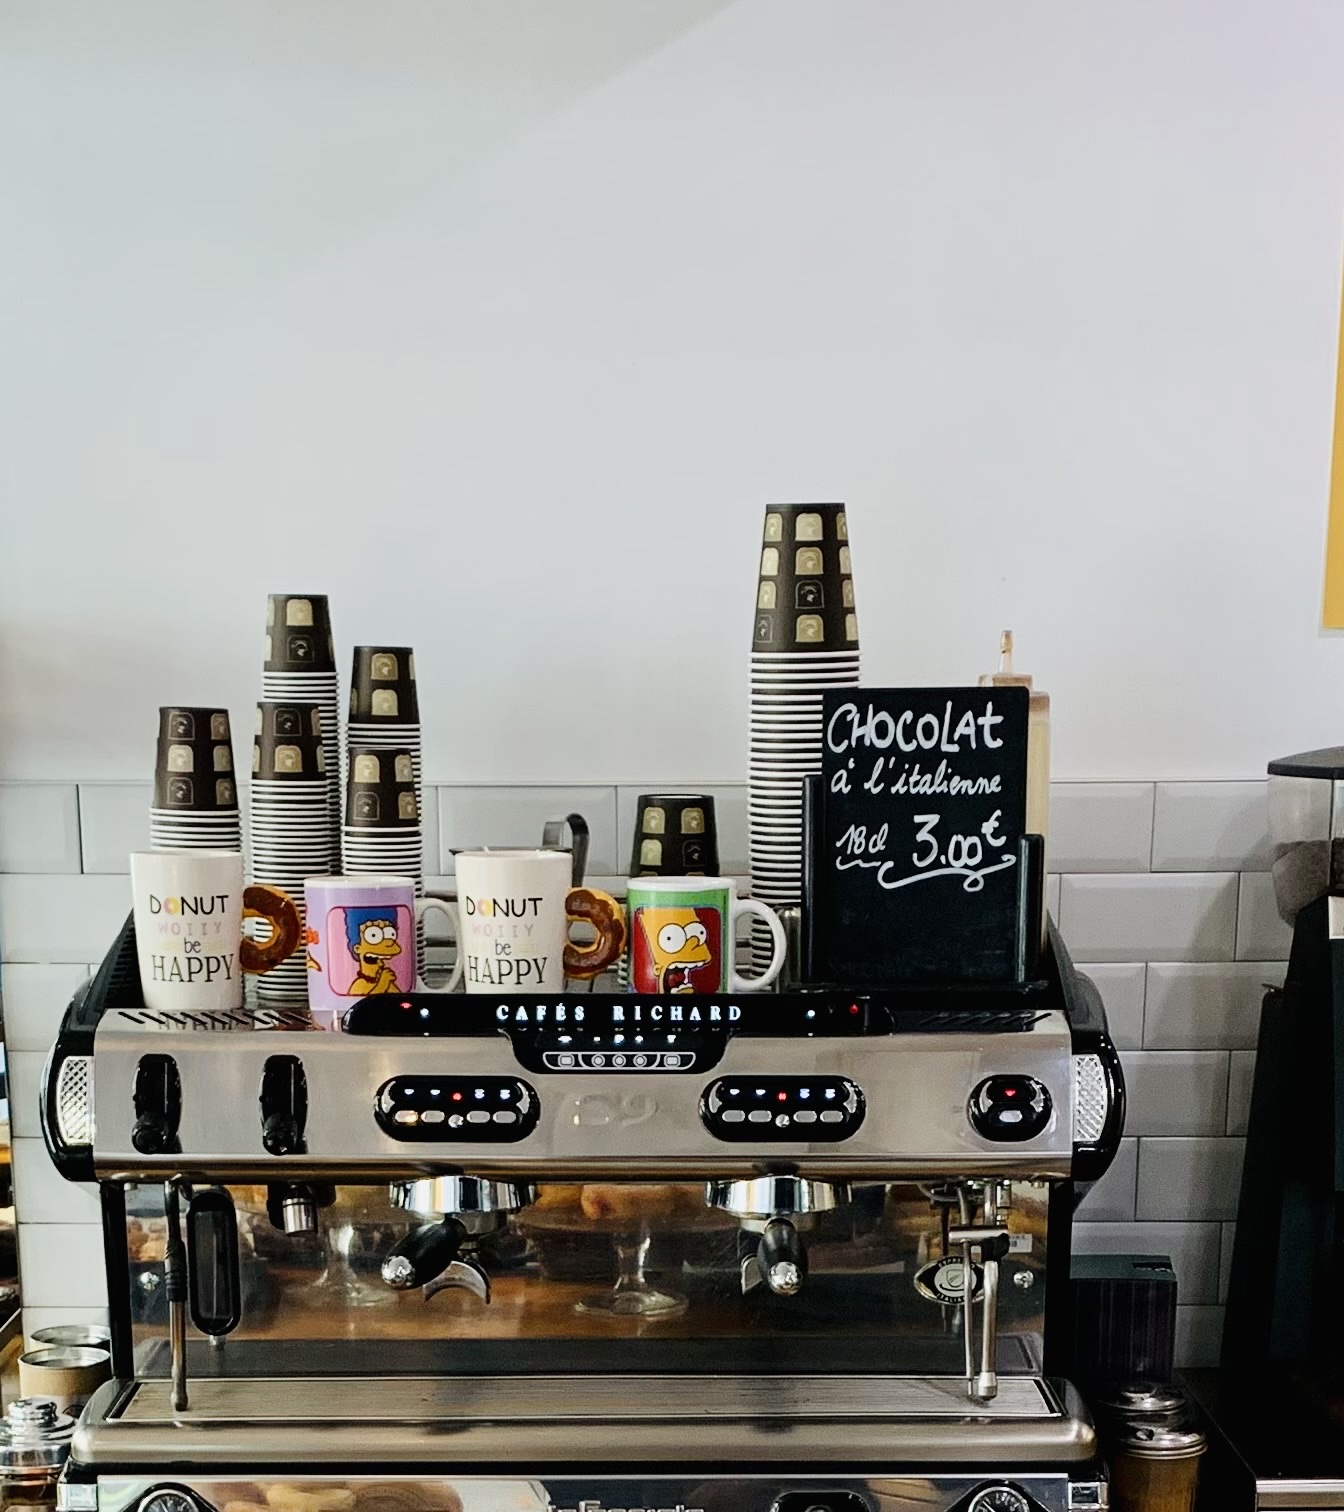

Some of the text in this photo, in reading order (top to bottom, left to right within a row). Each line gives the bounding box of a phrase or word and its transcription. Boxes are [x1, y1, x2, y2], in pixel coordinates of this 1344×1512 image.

[183, 936, 202, 955] be
[494, 938, 513, 957] be
[151, 953, 235, 983] HAPPY
[467, 955, 549, 985] HAPPY
[496, 1002, 742, 1022] CAFÉS RICHARD
